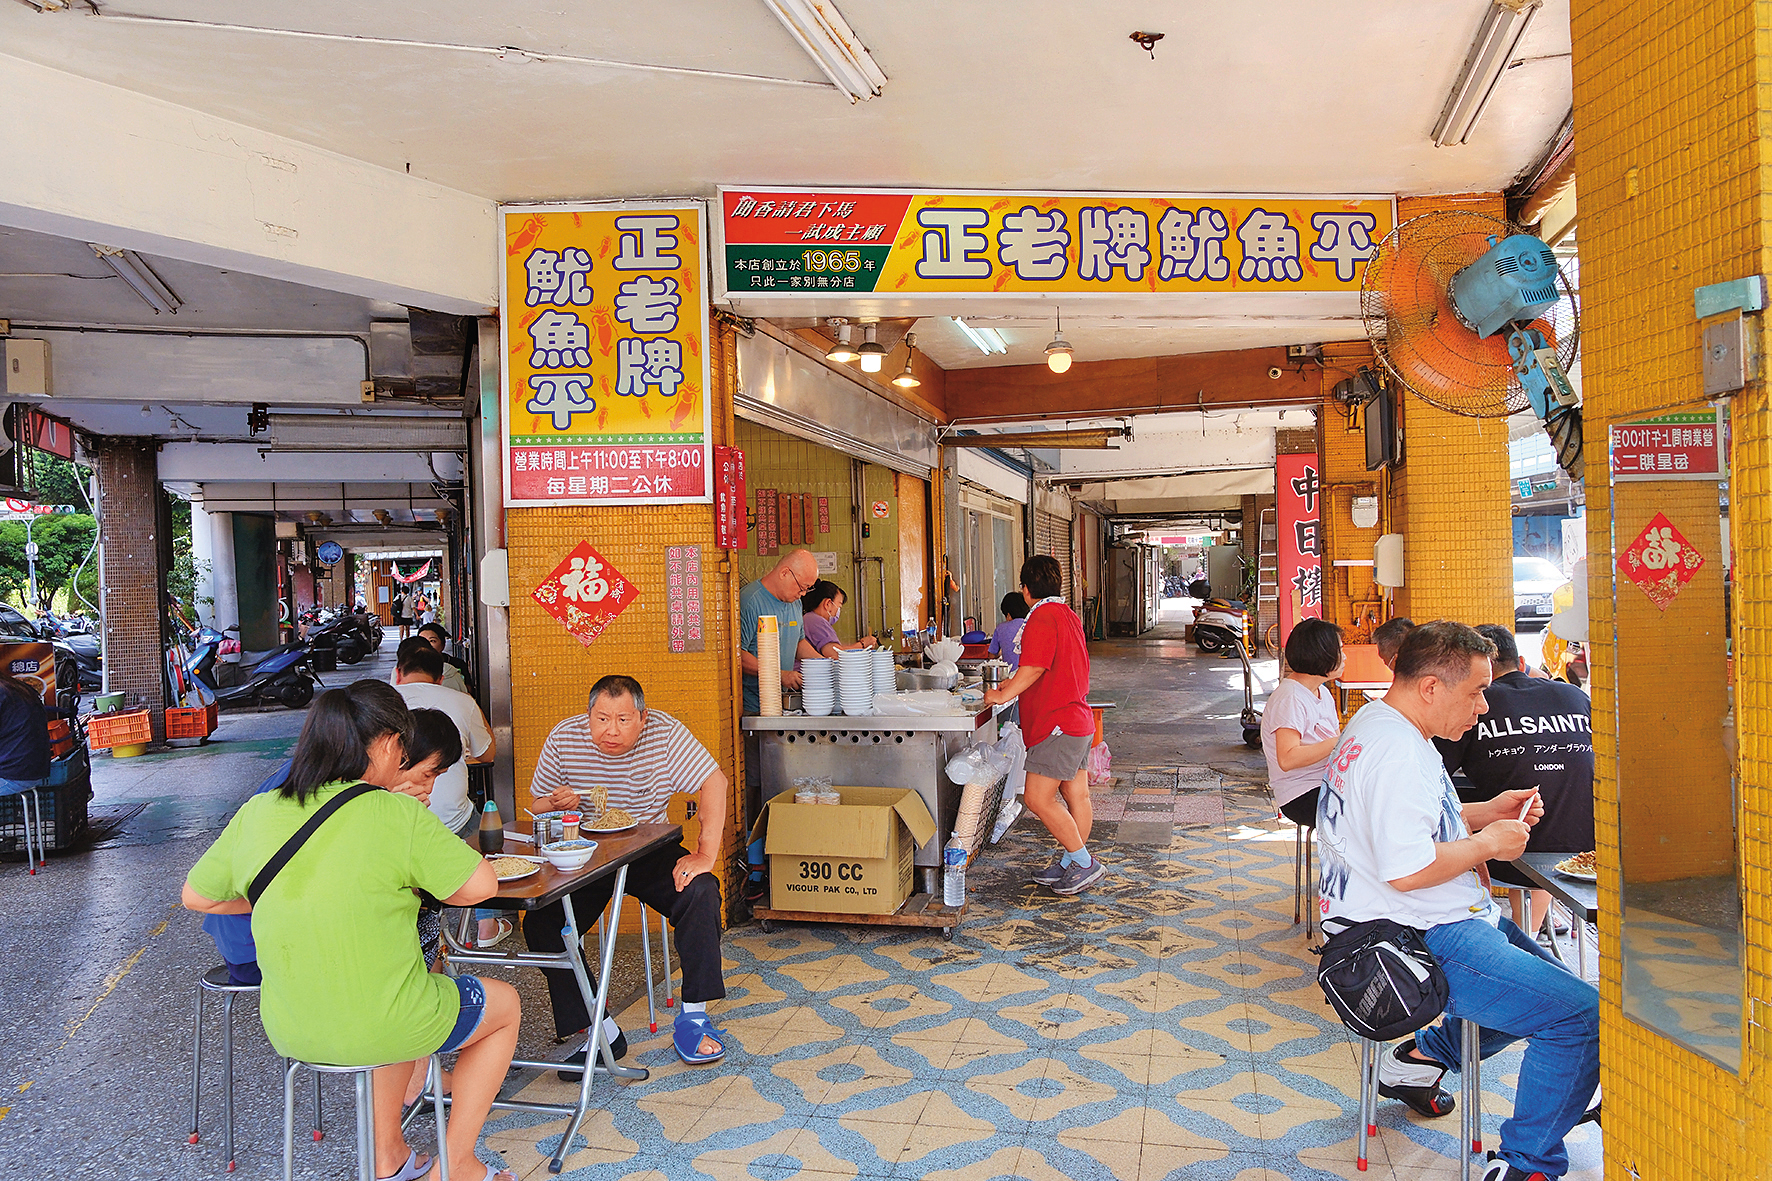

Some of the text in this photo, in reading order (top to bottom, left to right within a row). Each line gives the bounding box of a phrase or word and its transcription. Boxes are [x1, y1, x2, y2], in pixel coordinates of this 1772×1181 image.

[731, 197, 857, 218] 聞香請君下馬
[785, 223, 887, 241] 一試成主顧
[915, 206, 1377, 281] 正老牌魷魚平
[750, 276, 855, 288] 只此一家別無分店
[612, 215, 685, 397] 正老牌
[524, 246, 597, 431] 魷魚平
[514, 449, 702, 472] 營業時間上午11:00至下午8:00
[547, 475, 673, 495] 每星期二公休
[559, 556, 609, 602] 福
[11, 660, 38, 672] 總店
[1488, 745, 1526, 758] トウキョウ
[1533, 763, 1565, 771] LONDON
[799, 861, 864, 881] 390 CC
[786, 884, 877, 895] VIGOUR PAK CO., LTD
